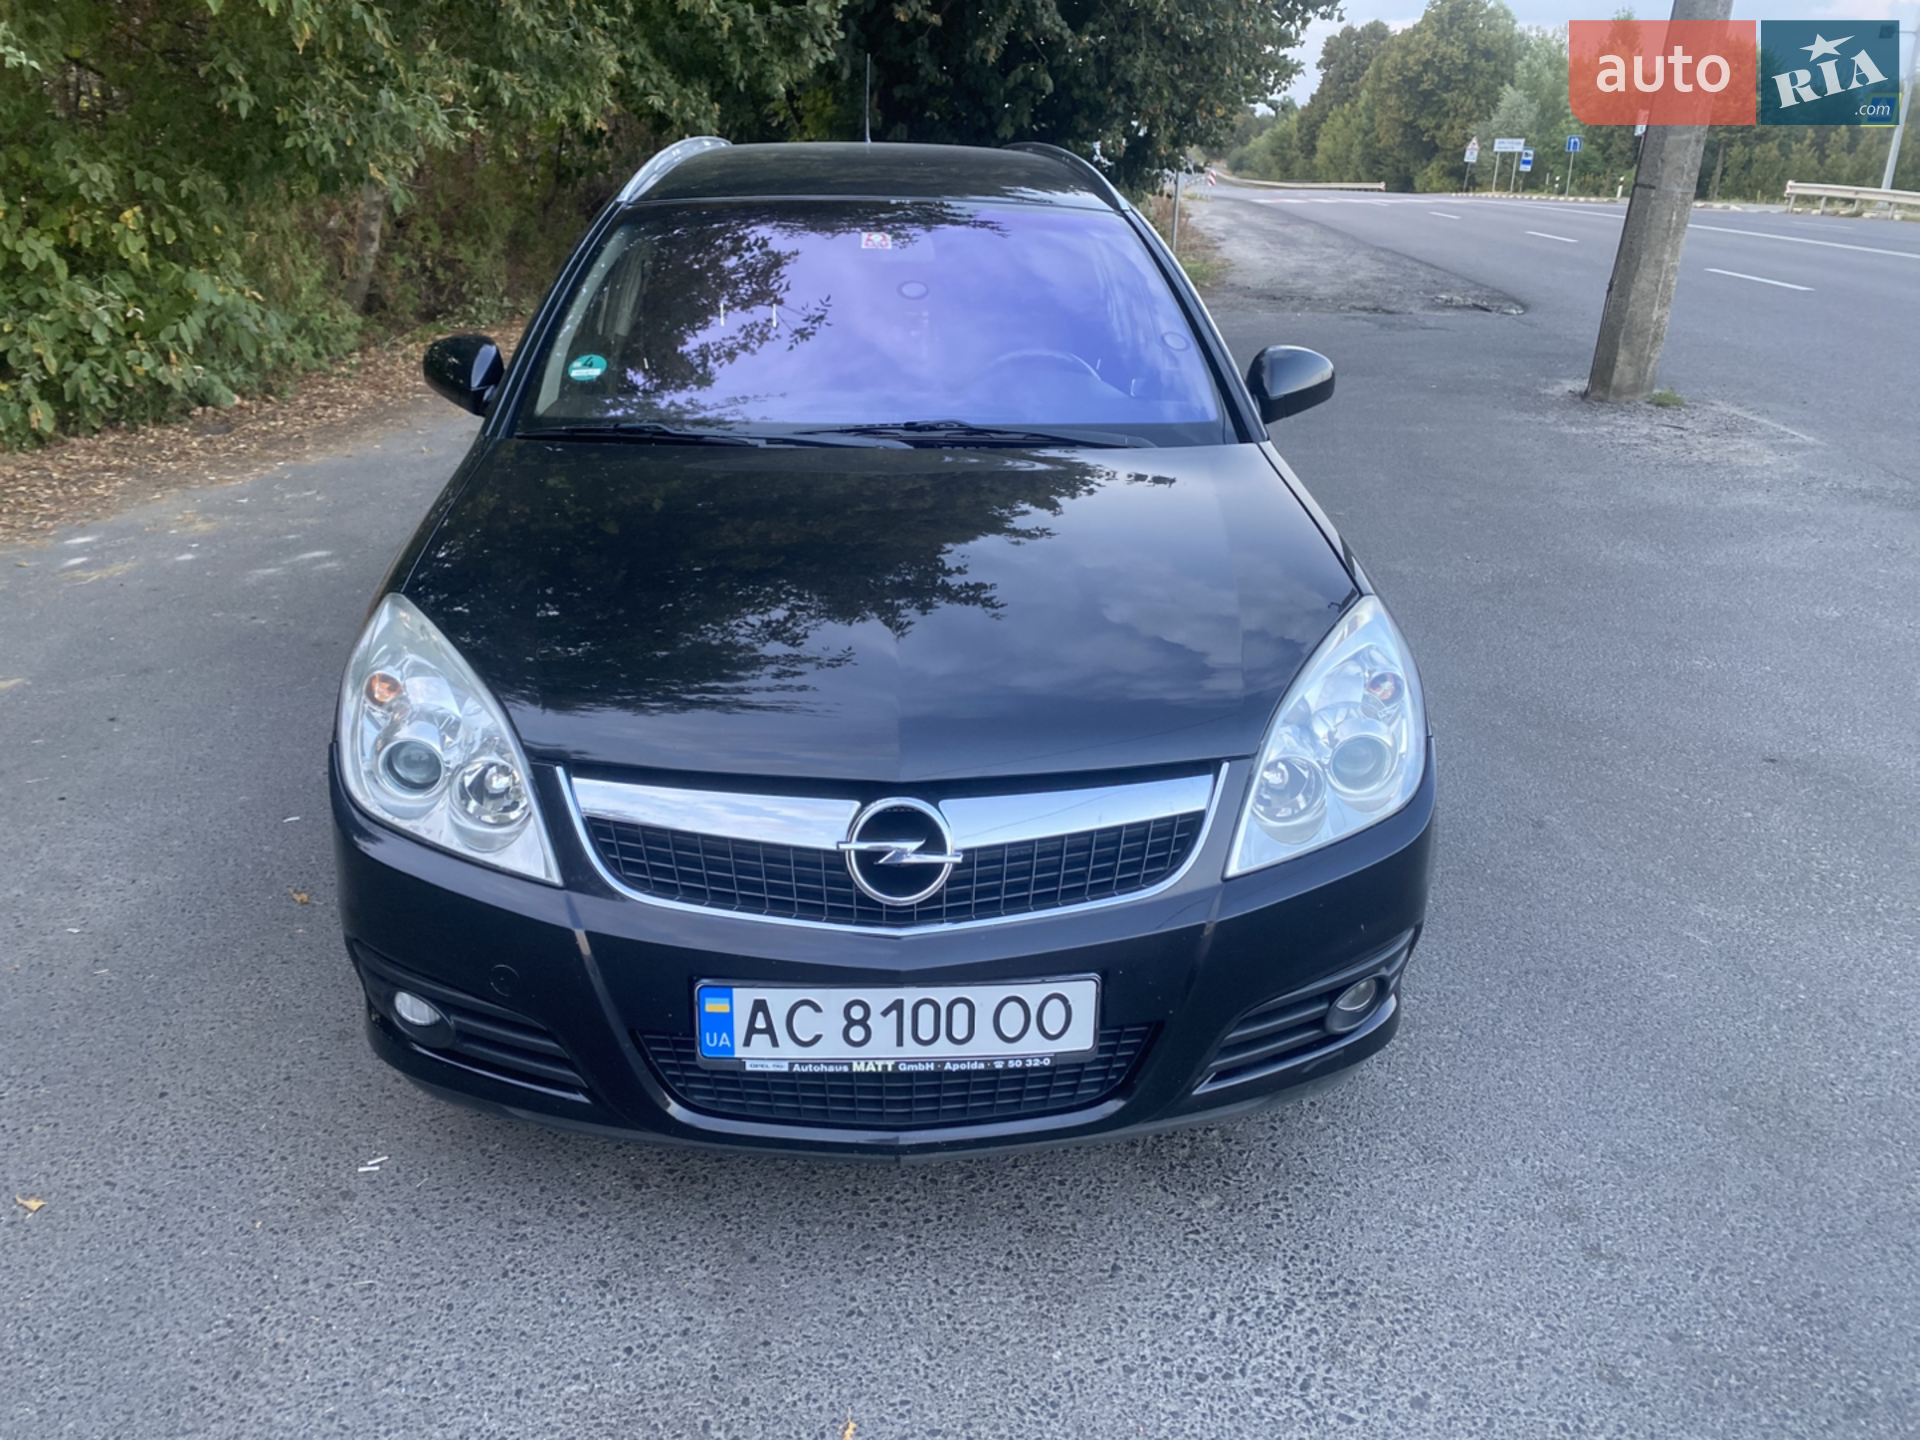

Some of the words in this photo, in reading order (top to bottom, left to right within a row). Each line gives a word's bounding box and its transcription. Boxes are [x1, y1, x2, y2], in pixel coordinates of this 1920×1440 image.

[582, 356, 594, 368] 4
[743, 998, 824, 1048] AC
[842, 996, 976, 1047] 8100
[706, 1032, 732, 1047] UA
[792, 1063, 849, 1073] Autohaus
[852, 1061, 895, 1072] MATT
[898, 1062, 935, 1072] GmbH
[944, 1061, 985, 1072] Apolda
[1007, 1059, 1023, 1068] 50
[1025, 1057, 1051, 1068] 32-0
